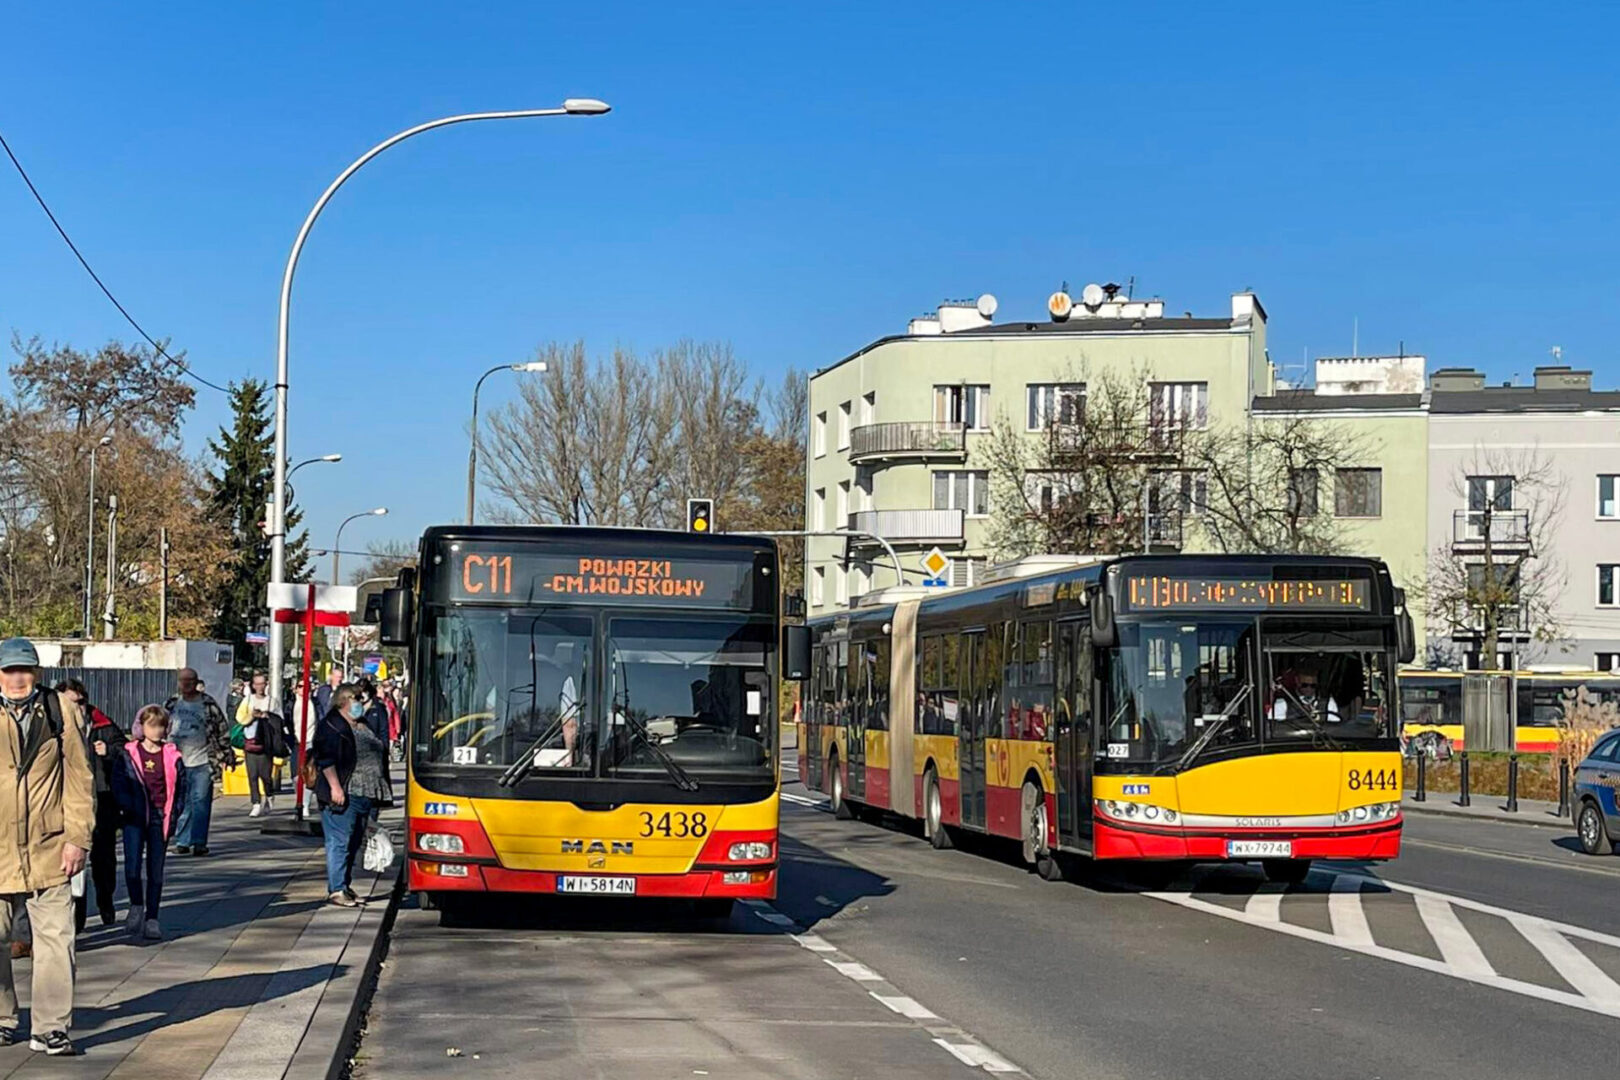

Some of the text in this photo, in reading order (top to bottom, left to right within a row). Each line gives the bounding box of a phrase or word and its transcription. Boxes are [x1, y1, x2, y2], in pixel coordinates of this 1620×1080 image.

[463, 554, 513, 594] C11
[579, 558, 672, 578] POWĄZKI
[456, 749, 472, 761] 21
[1109, 745, 1128, 756] 027
[1348, 769, 1398, 791] 8444
[638, 811, 708, 838] 3438
[1235, 818, 1281, 827] SOLARIS
[561, 840, 634, 855] MAN
[590, 878, 634, 892] 5814N
